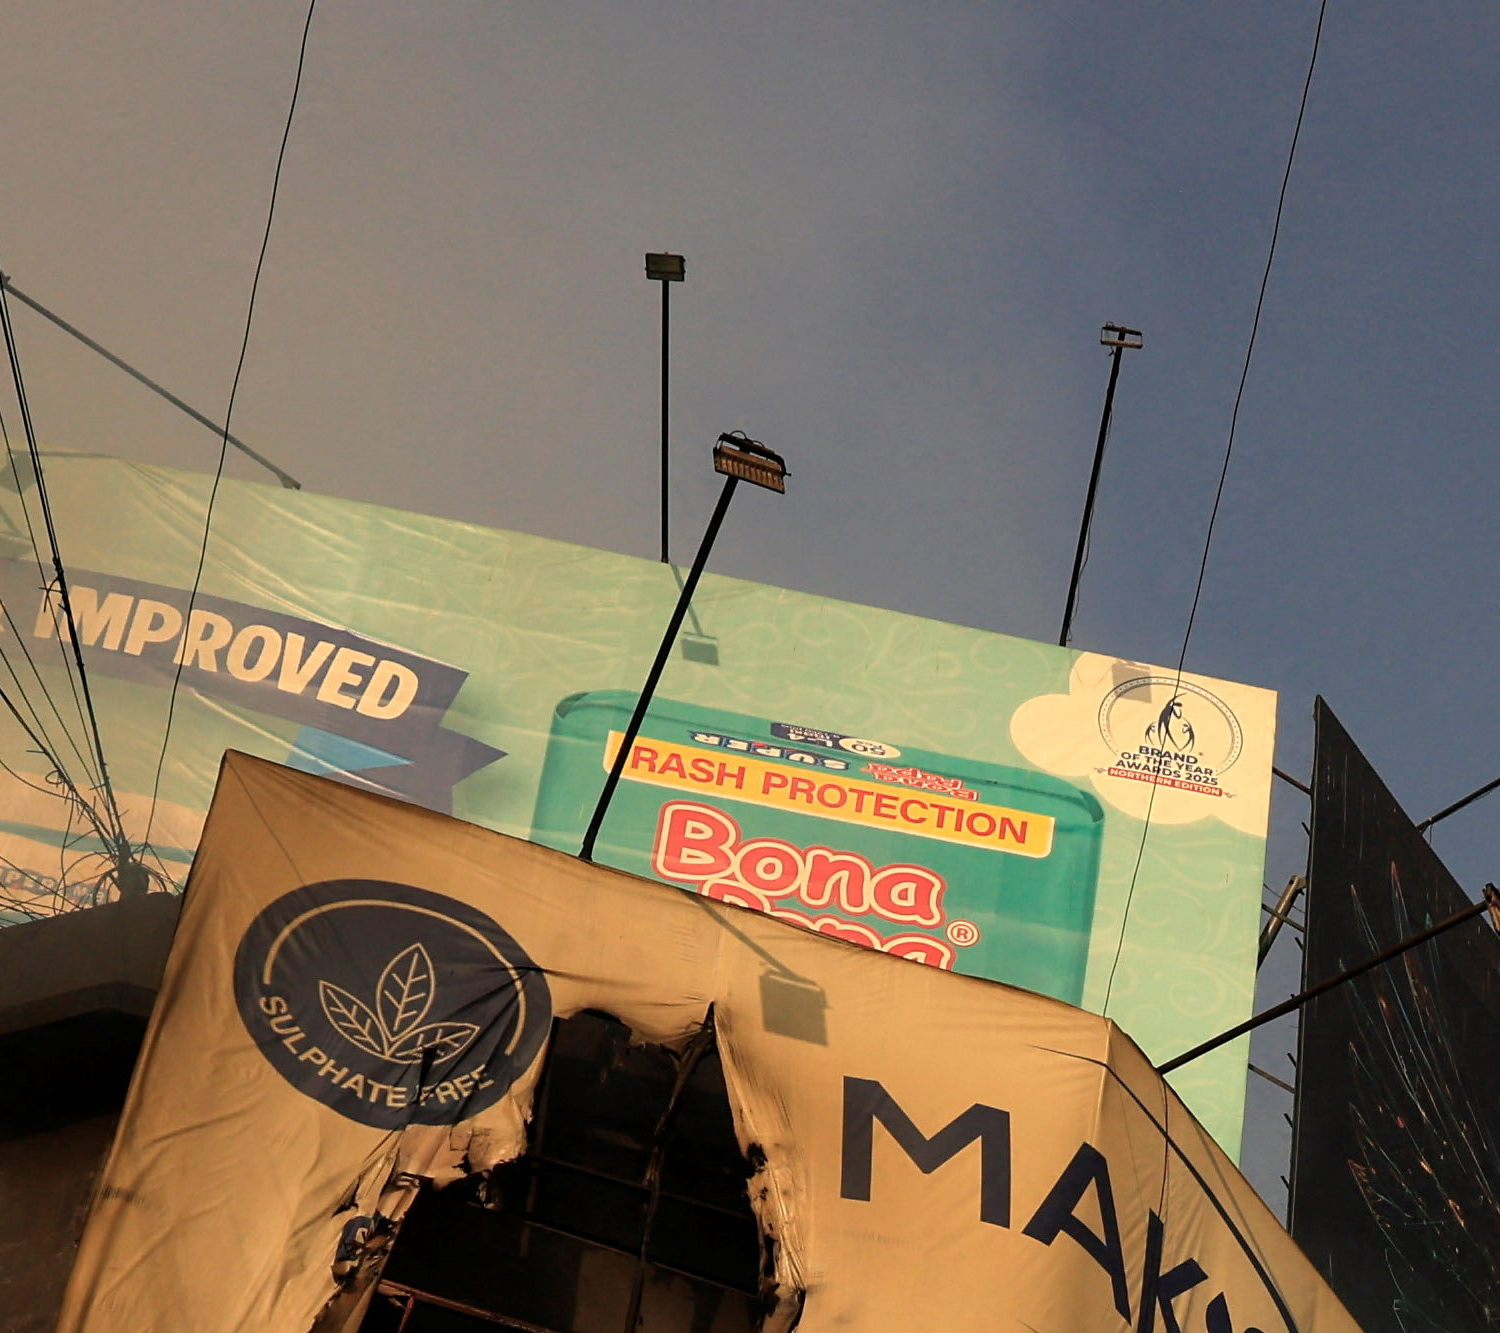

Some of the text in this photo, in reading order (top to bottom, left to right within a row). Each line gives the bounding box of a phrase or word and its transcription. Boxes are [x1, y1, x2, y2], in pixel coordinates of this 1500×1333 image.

[36, 577, 422, 722] IMPROVED
[1109, 768, 1221, 797] NORTHERN EDITION
[1115, 758, 1219, 786] AWARDS 2025
[1121, 751, 1214, 777] OF THE YEAR
[1138, 745, 1199, 765] BRAND
[629, 744, 1029, 845] RASH PROTECTION
[652, 800, 947, 929] Bona
[258, 995, 496, 1108] SULPHATE FREE
